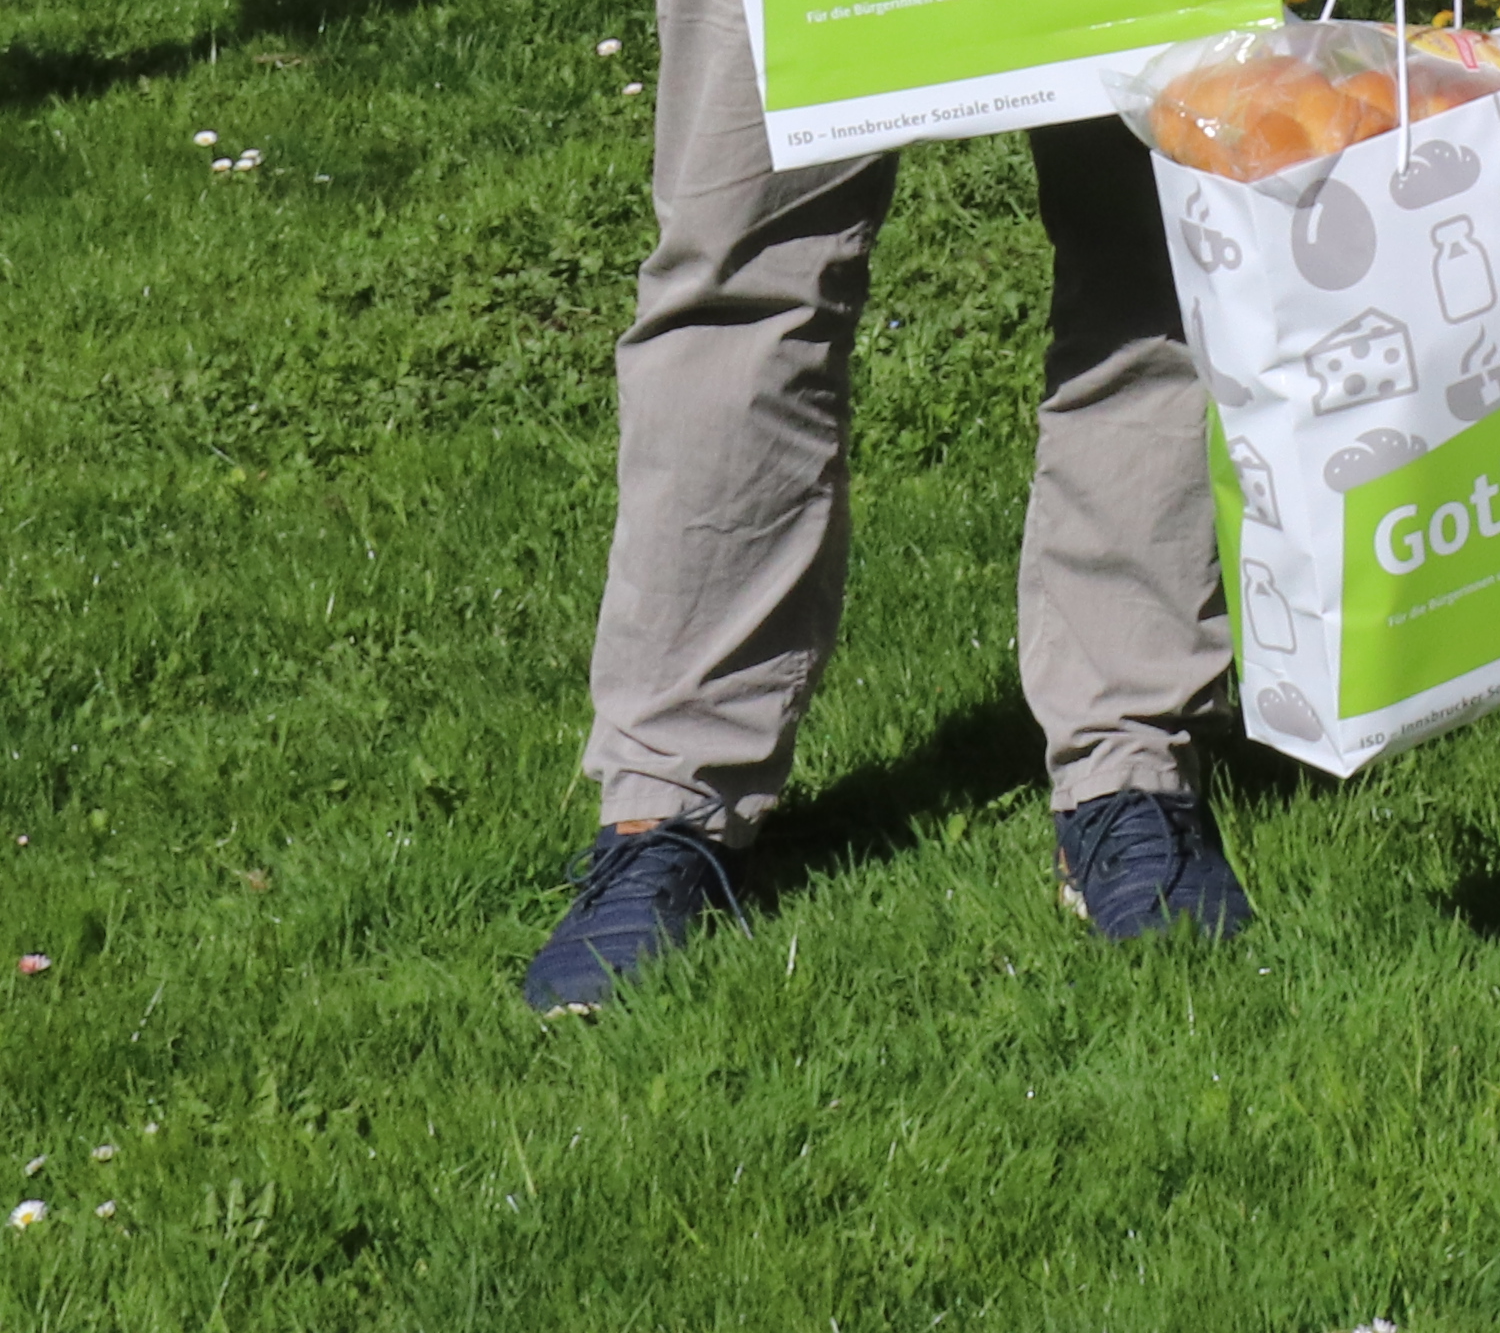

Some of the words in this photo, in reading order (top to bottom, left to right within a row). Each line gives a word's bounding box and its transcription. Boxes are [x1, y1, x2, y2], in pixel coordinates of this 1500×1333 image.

[806, 9, 828, 24] Für
[831, 3, 851, 19] die
[788, 132, 814, 147] ISD
[831, 112, 927, 140] Innsbrucker
[930, 101, 990, 123] Soziale
[993, 90, 1056, 112] Dienste
[1388, 612, 1407, 628] Für
[1409, 603, 1427, 619] die
[1359, 732, 1386, 749] ISD
[1401, 693, 1483, 734] Innsbrucker
